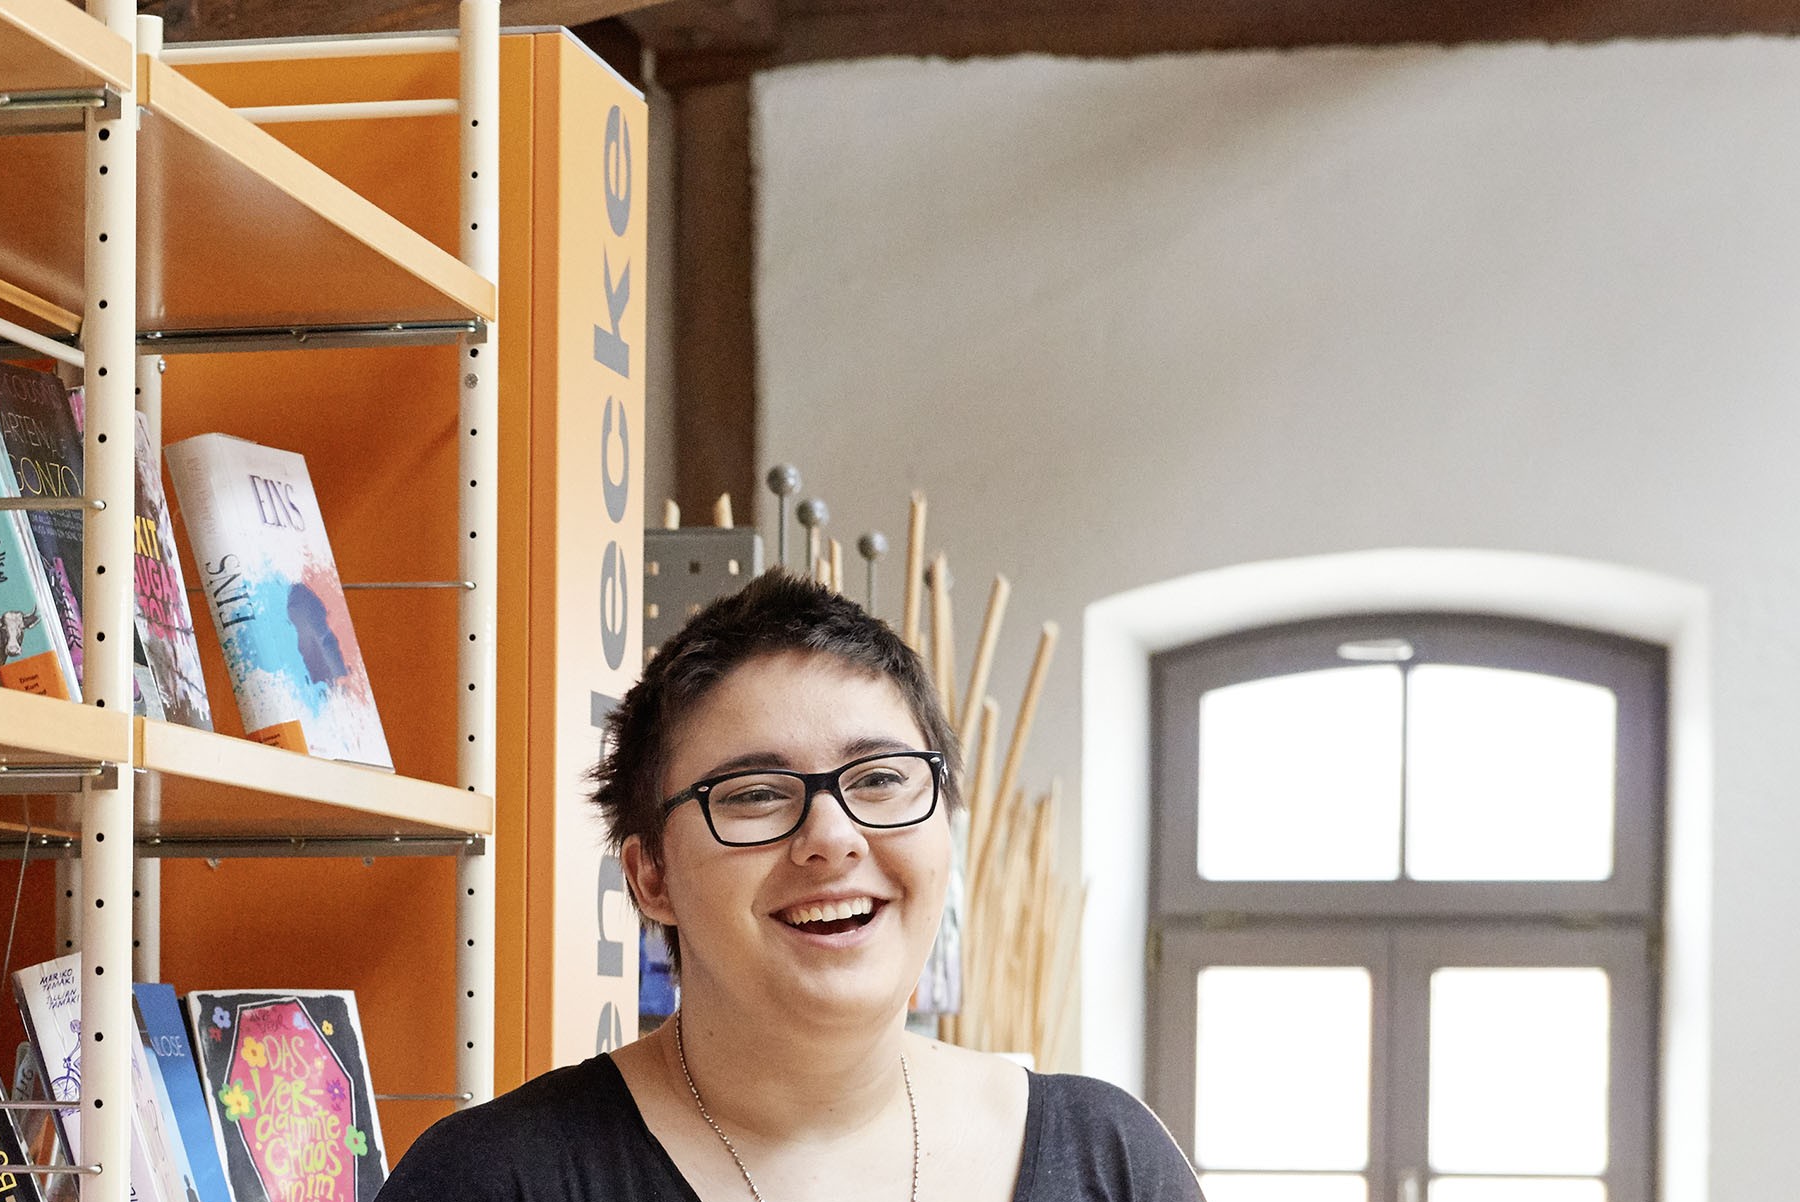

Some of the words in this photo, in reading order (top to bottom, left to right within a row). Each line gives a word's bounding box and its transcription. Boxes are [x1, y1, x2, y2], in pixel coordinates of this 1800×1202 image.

[248, 473, 307, 533] EINS
[134, 515, 161, 561] XIT
[205, 553, 257, 631] EINS
[39, 968, 74, 986] MARIKO
[42, 976, 76, 992] TAMAKI
[263, 1034, 311, 1081] DAS
[305, 1172, 336, 1201] im
